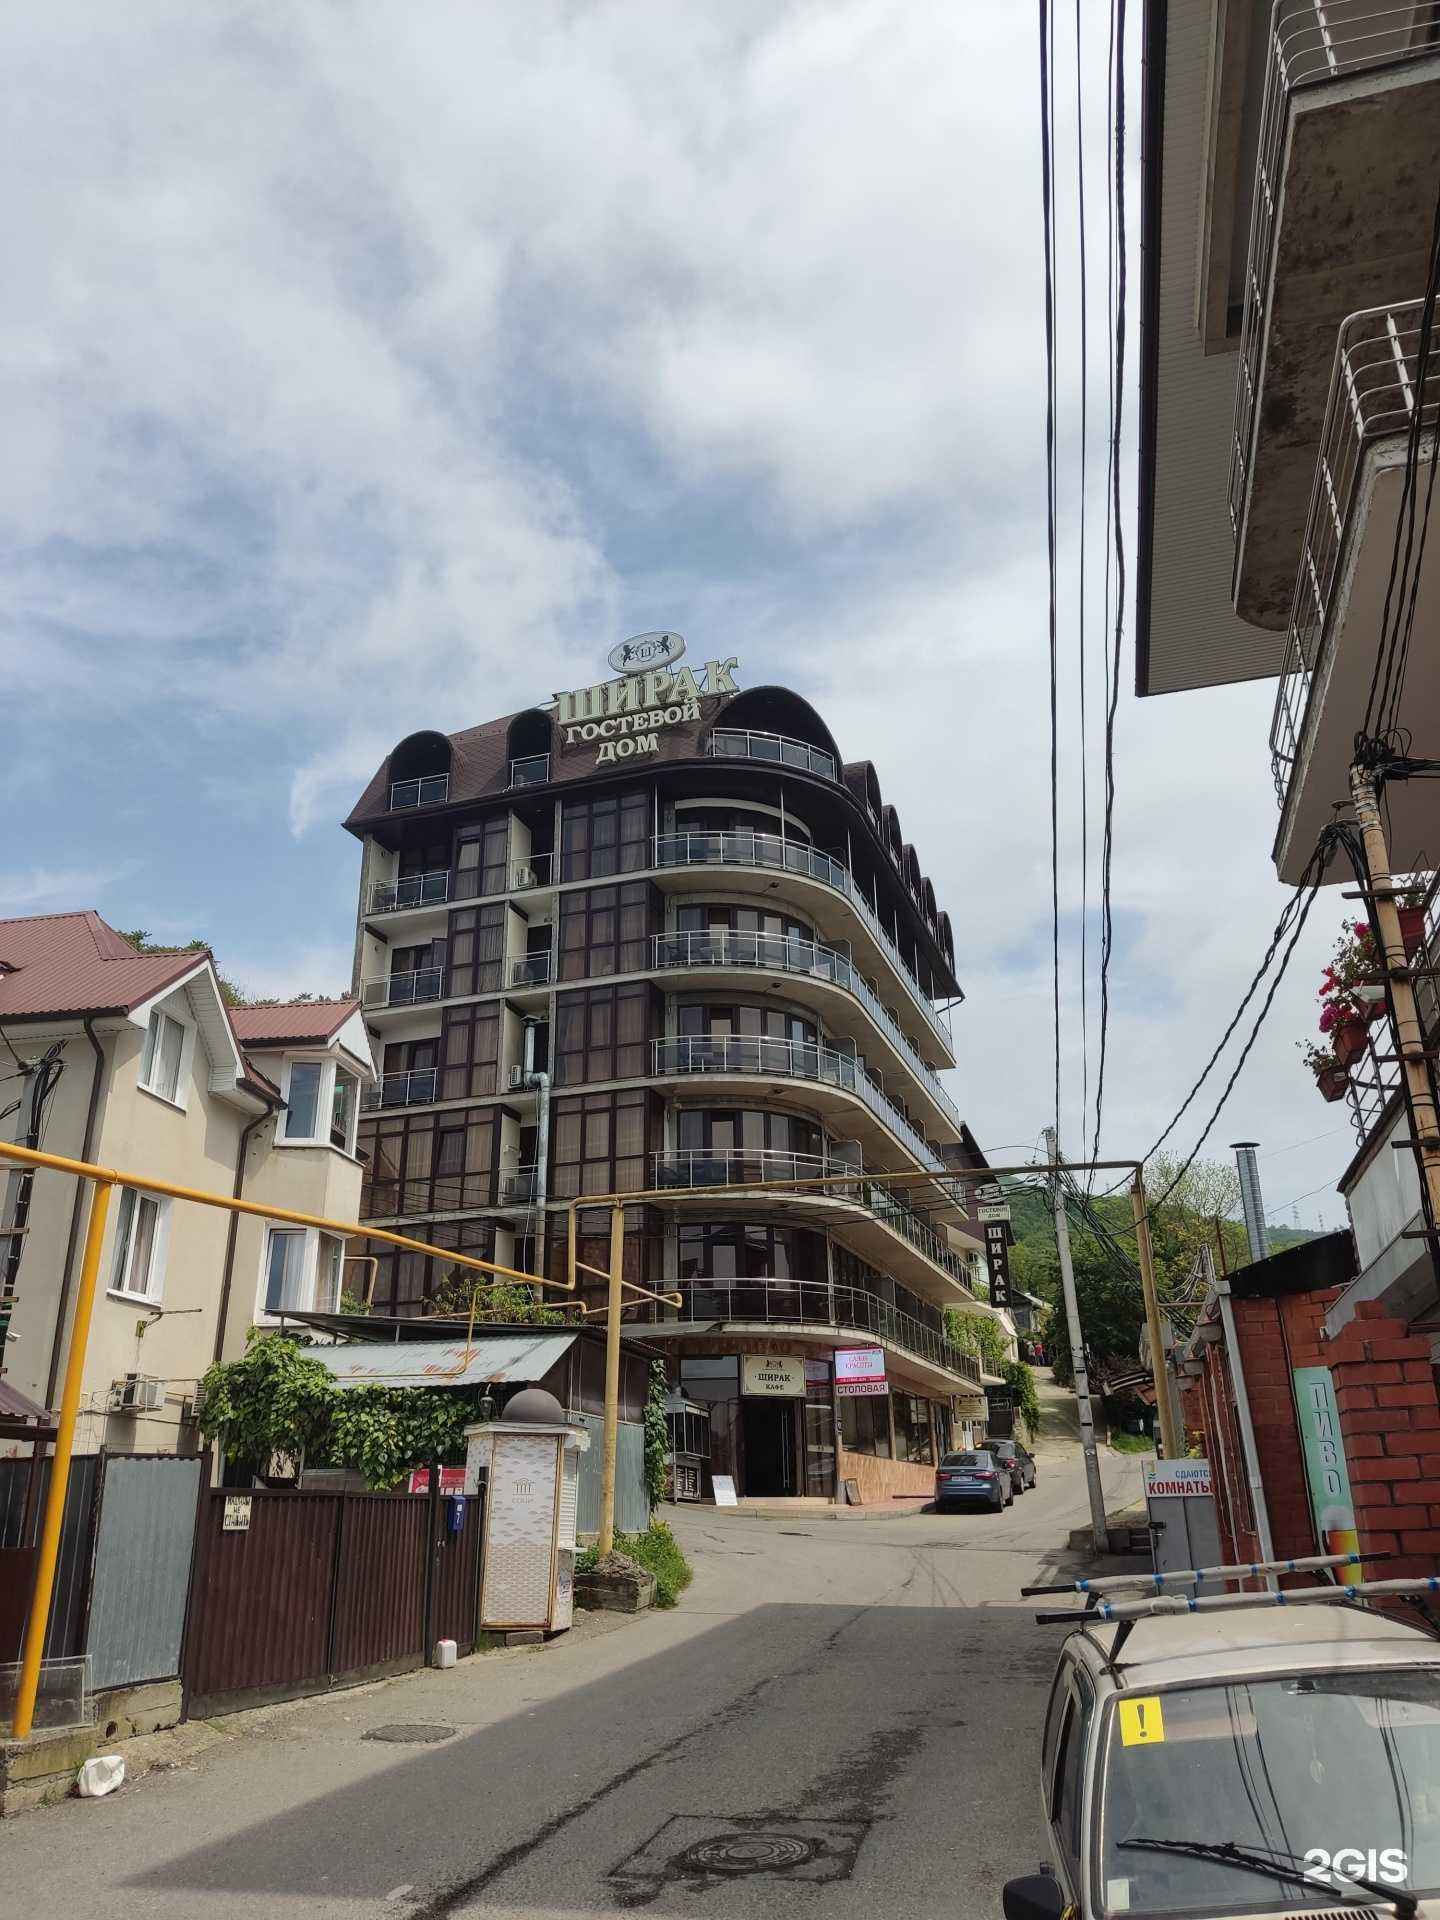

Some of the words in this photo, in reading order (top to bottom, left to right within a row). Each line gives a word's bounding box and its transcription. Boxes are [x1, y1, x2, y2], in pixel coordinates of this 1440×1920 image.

[558, 657, 740, 725] ШИРАК
[565, 697, 702, 744] ГОСТЕВОЙ
[595, 732, 660, 765] ДОМ
[987, 1227, 1007, 1302] ШИРАК
[758, 1373, 791, 1382] ШИРАК
[837, 1384, 885, 1394] СТОЛОВАЯ
[1309, 1382, 1342, 1496] ПИВО
[1175, 1469, 1210, 1480] СДАЮТС
